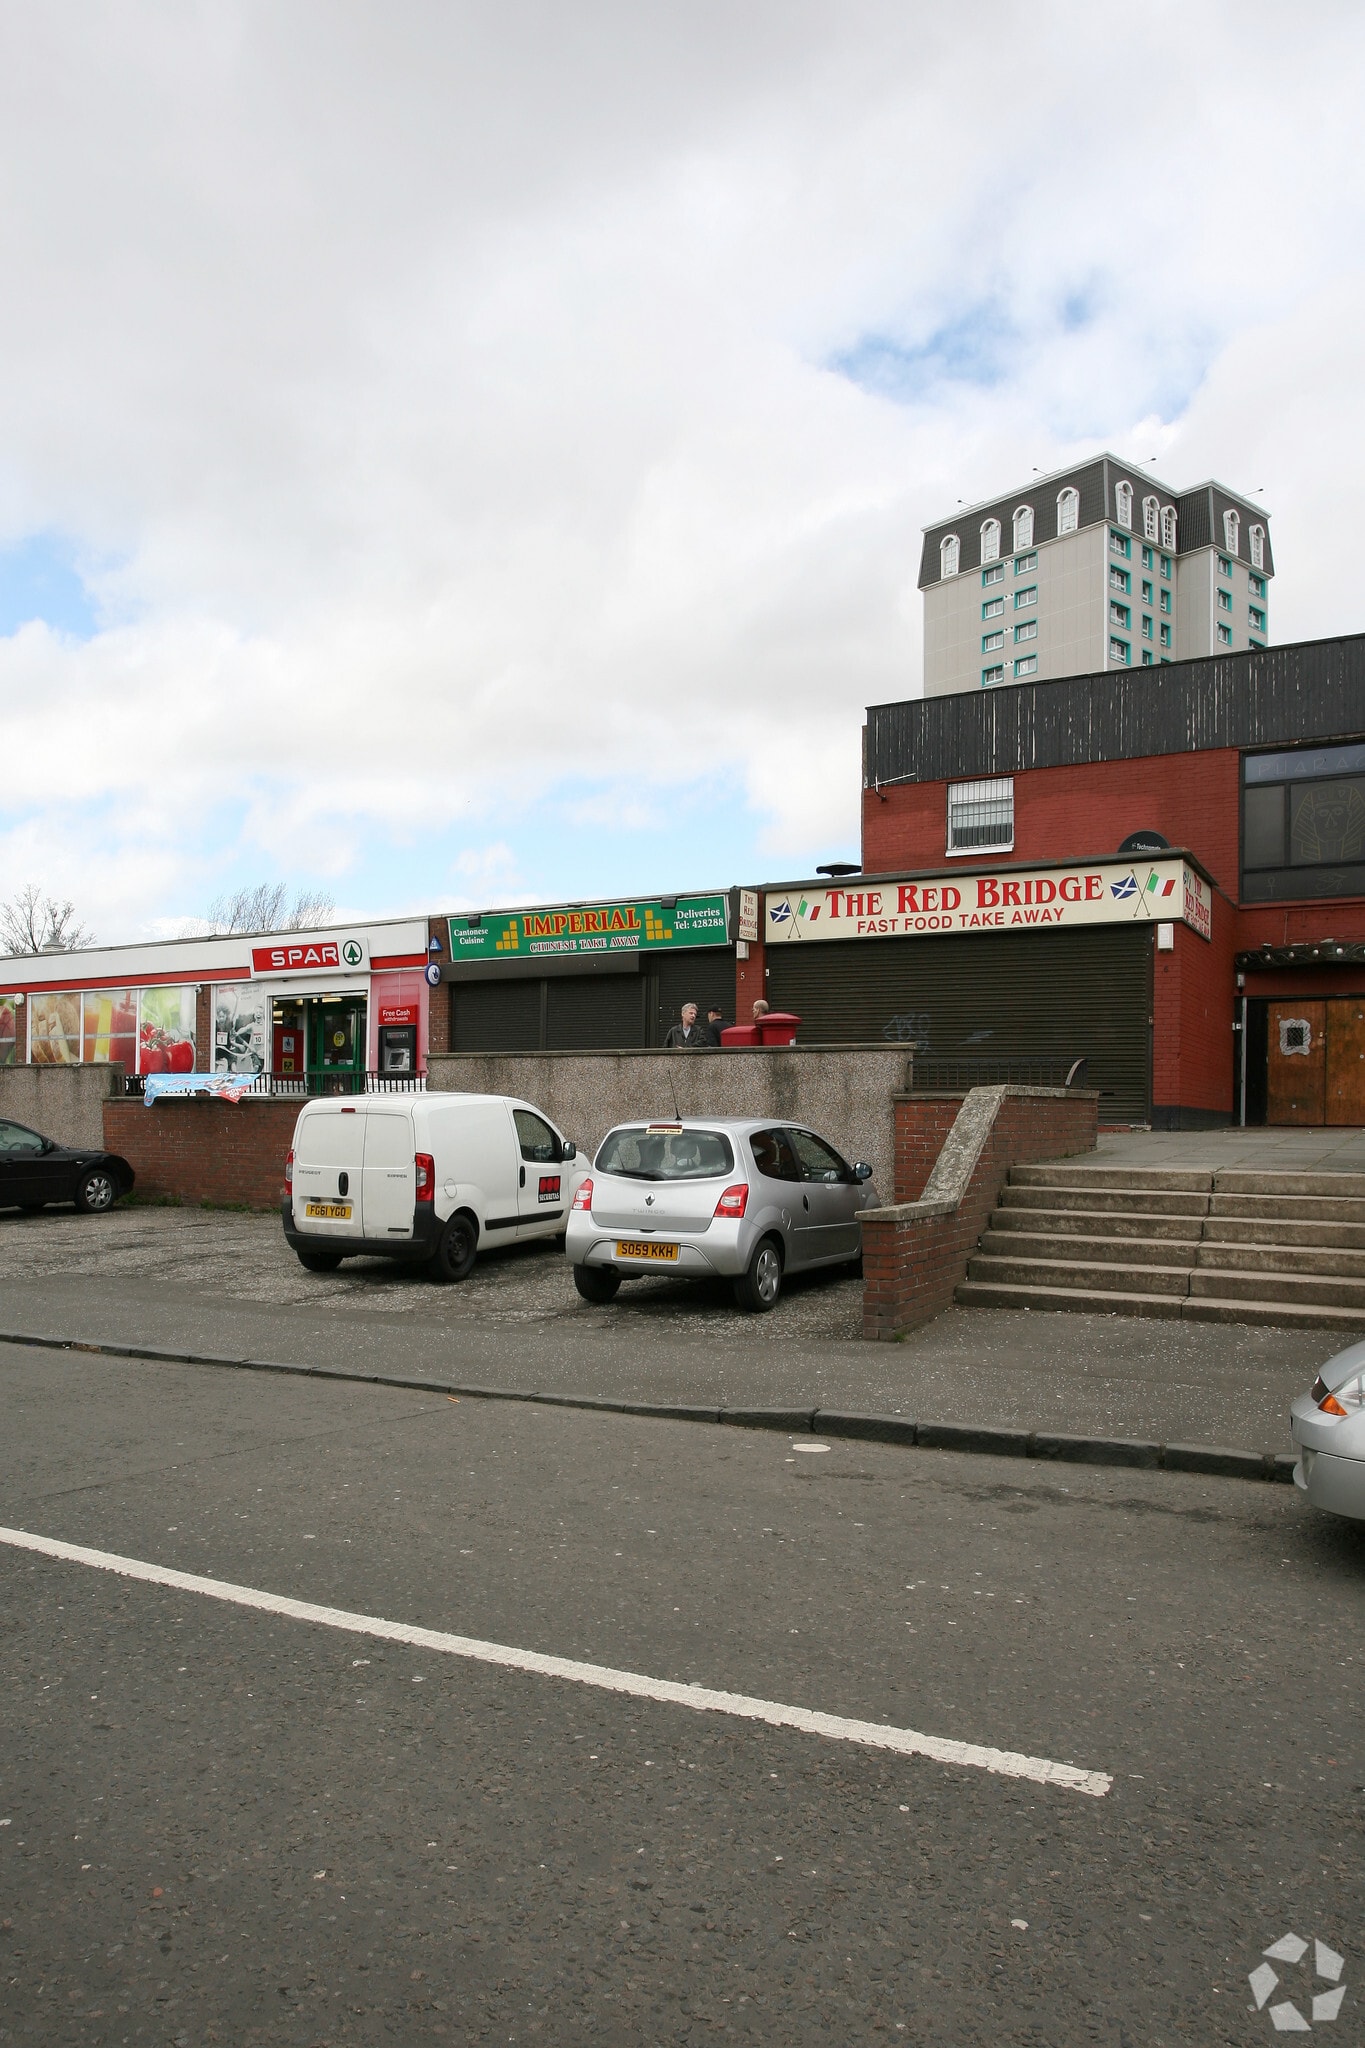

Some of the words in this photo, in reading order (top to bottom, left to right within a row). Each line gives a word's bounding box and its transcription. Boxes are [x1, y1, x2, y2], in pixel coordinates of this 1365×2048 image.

[744, 894, 754, 905] THE
[825, 889, 884, 919] THE
[896, 884, 962, 914] RED
[975, 875, 1105, 909] BRIDGE
[676, 908, 721, 920] Deliveries
[743, 905, 754, 917] RED
[522, 907, 642, 938] IMPERIAL
[673, 920, 690, 930] Tel:
[692, 917, 725, 929] 428288
[739, 916, 758, 930] BRIDGE
[857, 918, 899, 934] FAST
[904, 915, 953, 931] FOOD
[959, 911, 1005, 928] TAKE
[1011, 907, 1065, 925] AWAY
[453, 928, 489, 937] Cantonese
[459, 937, 485, 945] Cuisine
[530, 939, 577, 953] CHINESE
[579, 937, 607, 950] TAKE
[610, 935, 640, 948] AWAY
[270, 945, 338, 967] SPAR
[740, 971, 745, 980] 5
[382, 1009, 396, 1017] Free
[396, 1009, 411, 1017] Cash
[255, 1036, 262, 1044] 10
[539, 1192, 560, 1201] SECURITAS
[309, 1205, 328, 1216] FG61
[329, 1206, 346, 1217] YGO
[621, 1243, 649, 1257] SO59
[650, 1243, 673, 1258] KKH
